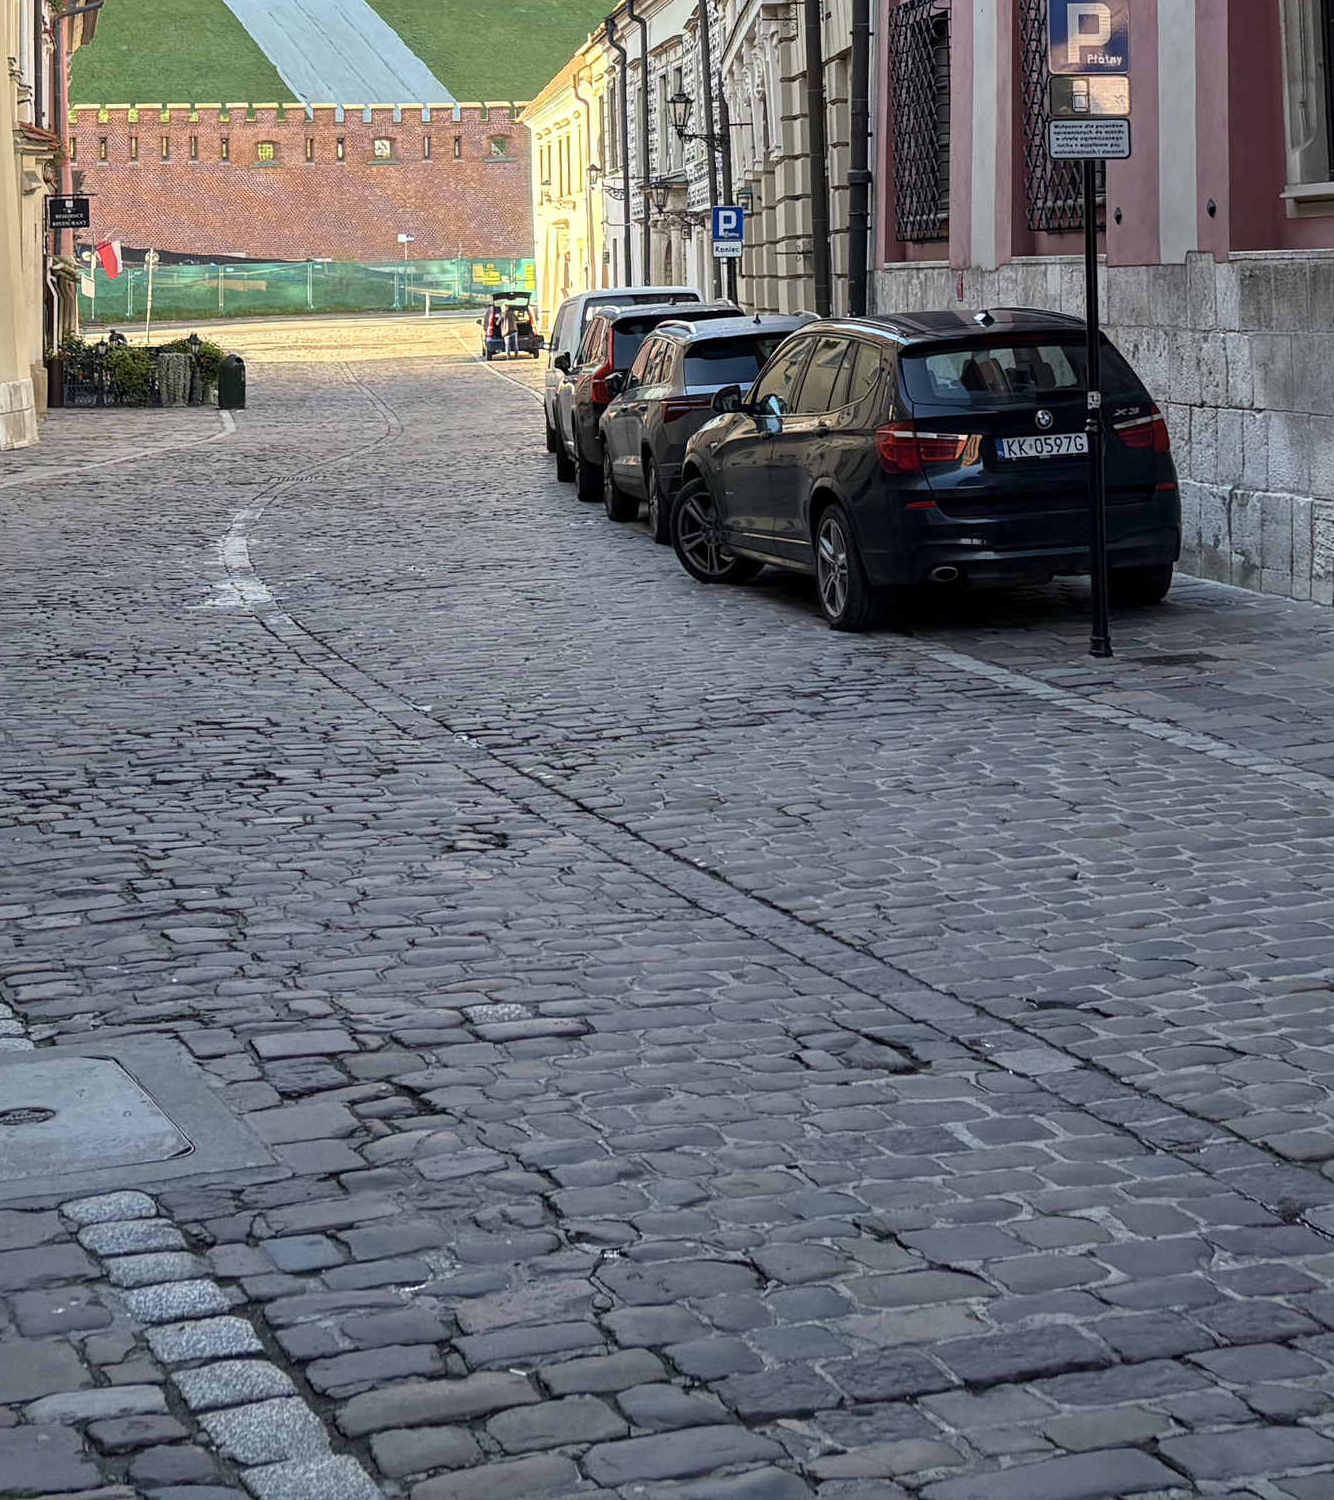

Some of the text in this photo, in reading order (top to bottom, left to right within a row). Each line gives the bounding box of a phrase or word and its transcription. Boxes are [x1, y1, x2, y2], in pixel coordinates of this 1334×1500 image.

[1067, 2, 1111, 64] P
[1087, 53, 1123, 67] Płatny
[1006, 434, 1085, 457] KK 0597G
